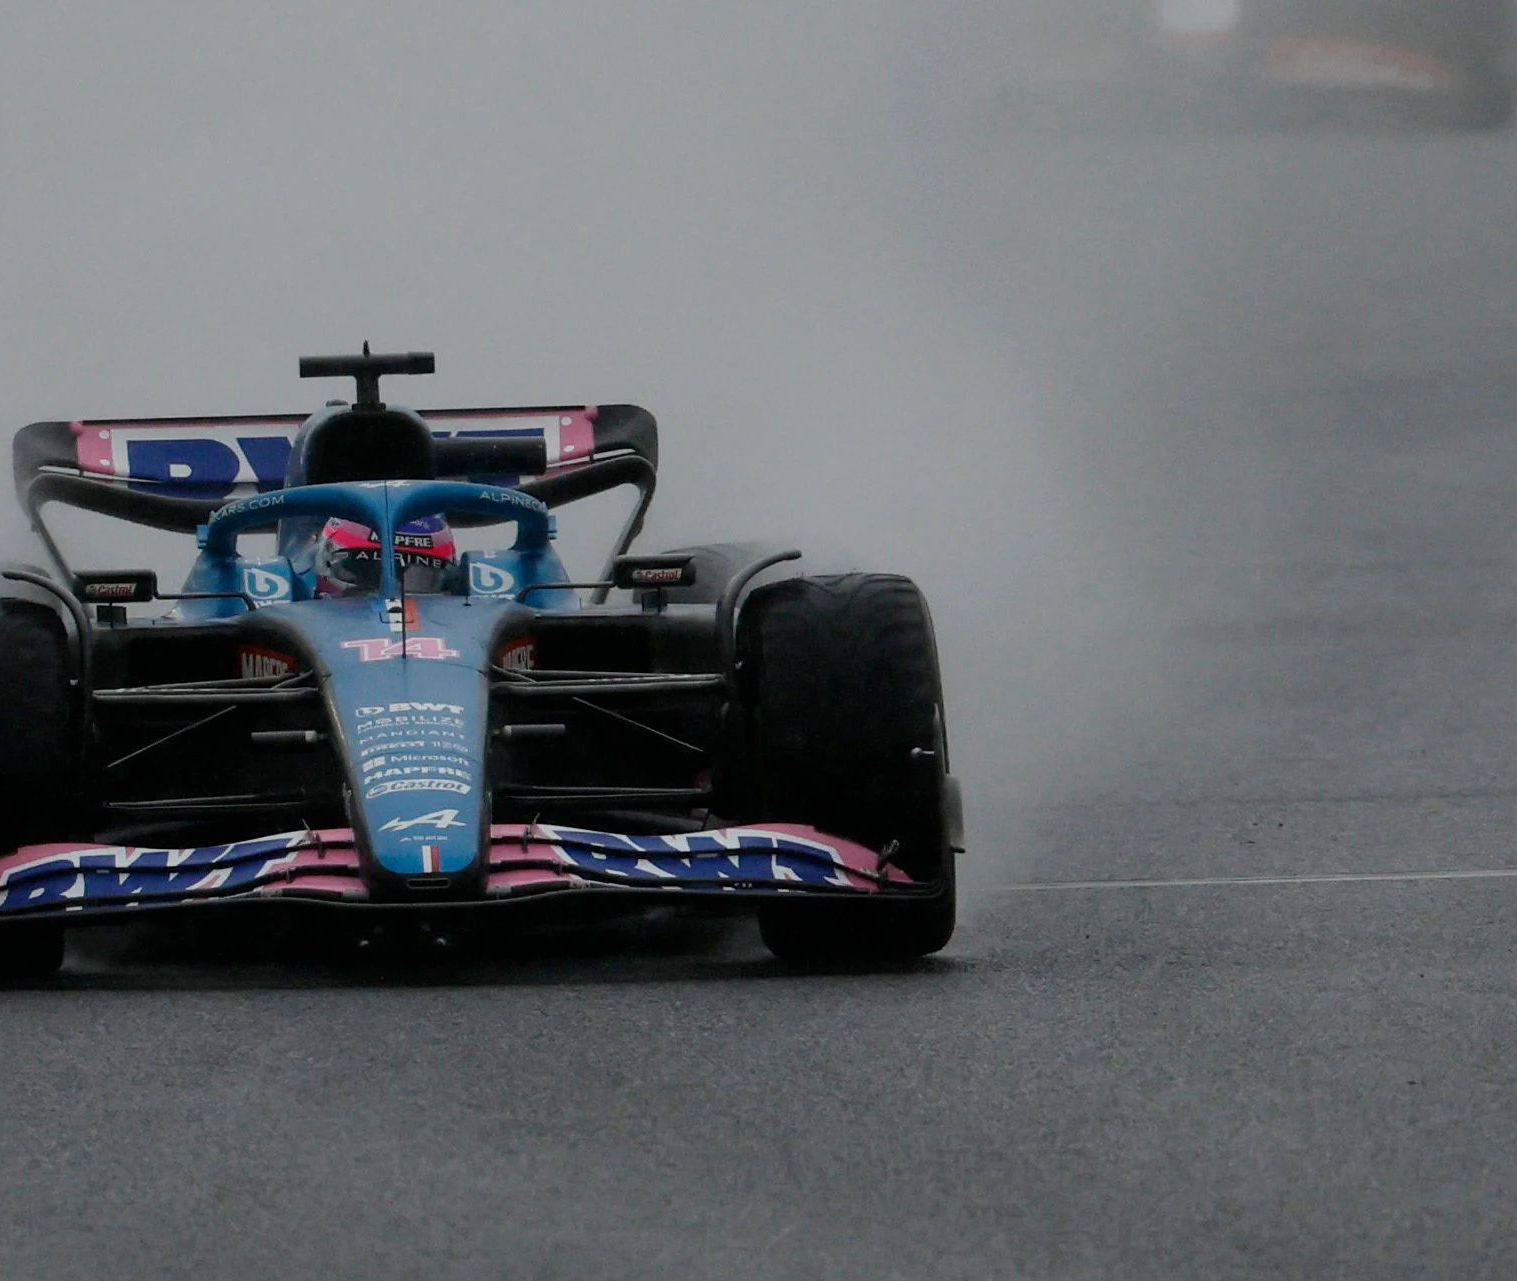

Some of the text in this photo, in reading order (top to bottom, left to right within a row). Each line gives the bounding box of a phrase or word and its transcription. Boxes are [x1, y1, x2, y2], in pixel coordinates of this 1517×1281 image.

[371, 531, 433, 547] MPFRE
[97, 584, 134, 597] Castrol
[340, 637, 460, 662] 14
[389, 702, 465, 715] BWT
[390, 755, 471, 767] Microsoft
[364, 766, 472, 785] MAPFRE
[390, 780, 465, 791] Castrol
[552, 828, 854, 890] BWT
